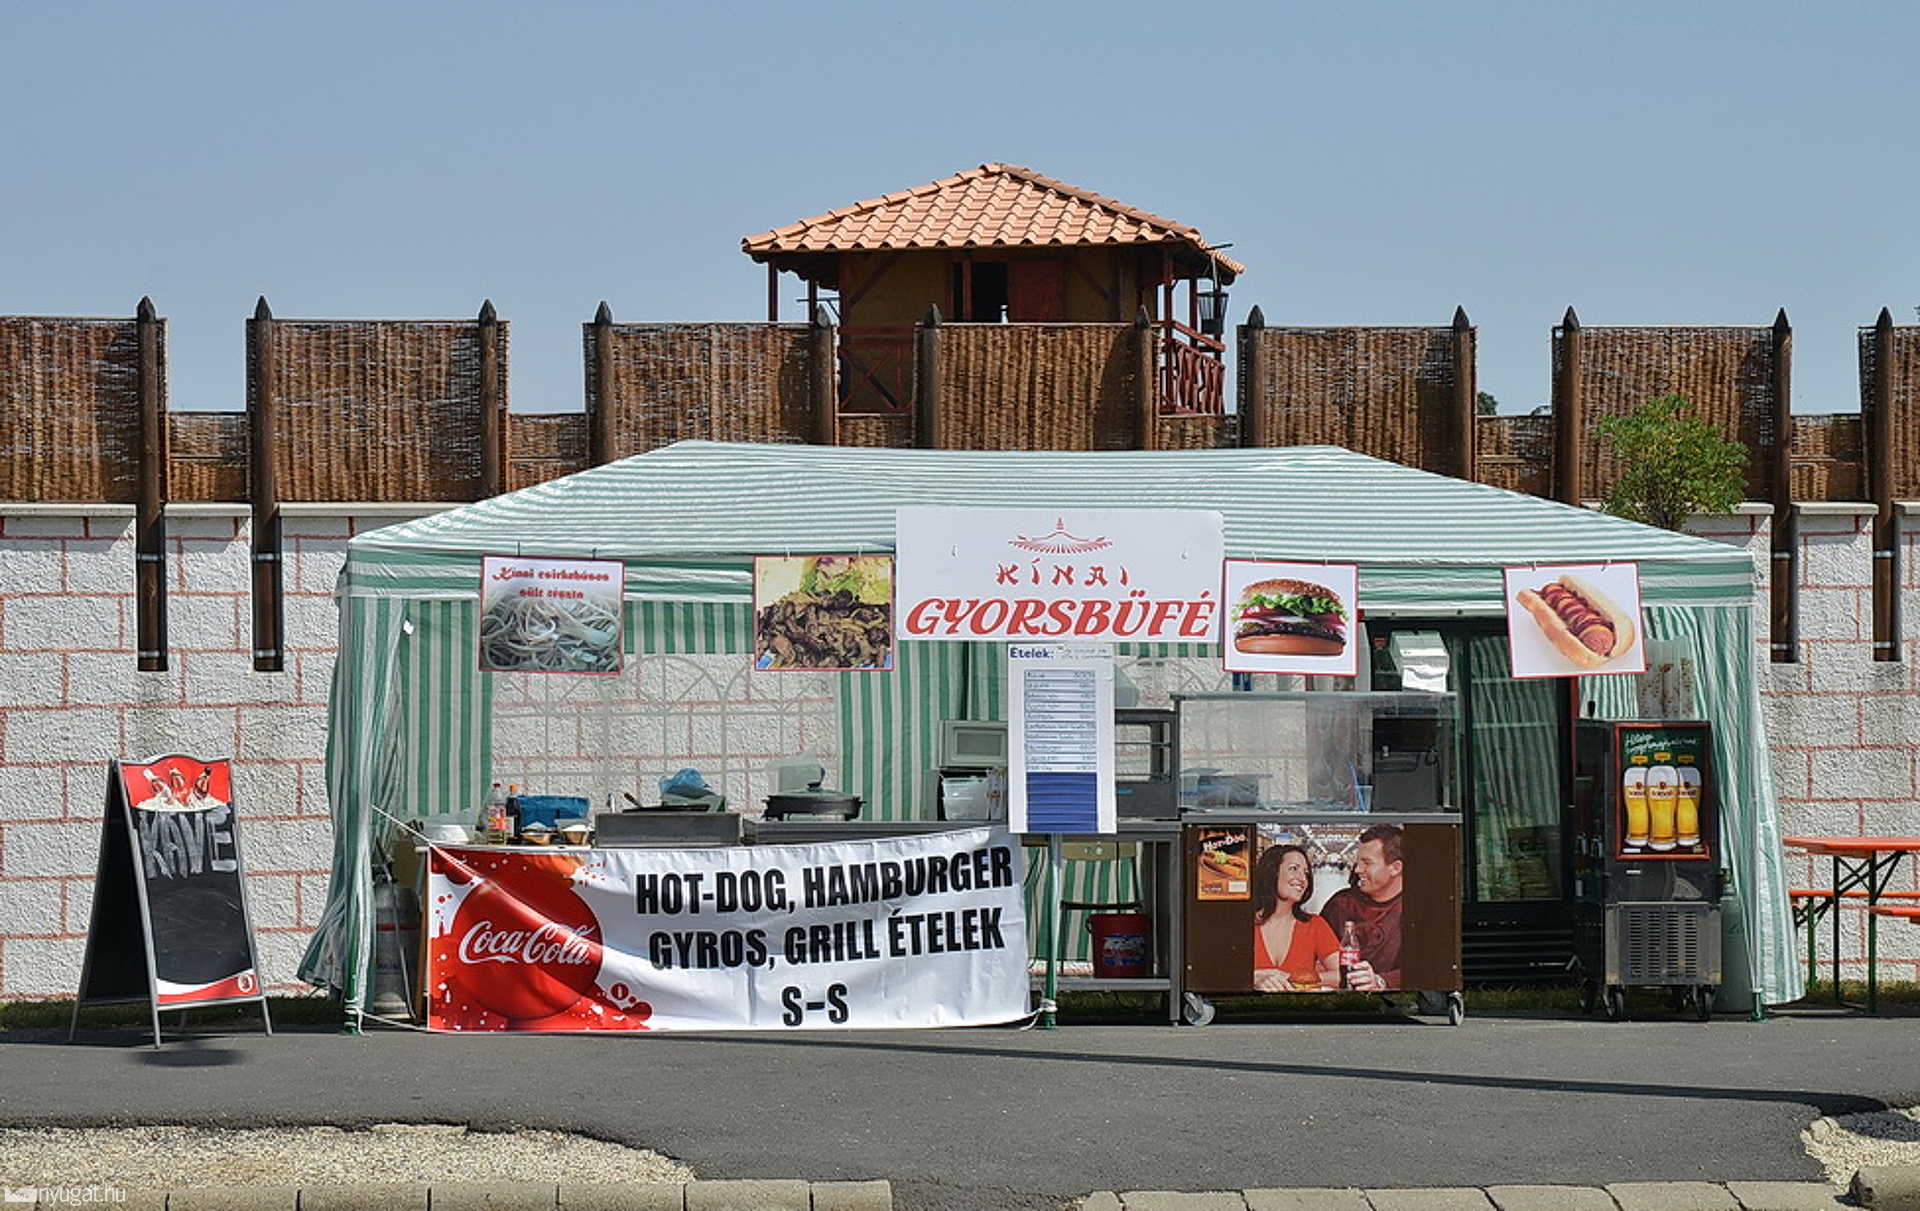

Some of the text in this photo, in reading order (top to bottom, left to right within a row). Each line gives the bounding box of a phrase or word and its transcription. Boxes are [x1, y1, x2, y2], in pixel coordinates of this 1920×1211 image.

[995, 557, 1129, 586] KÍNAI
[905, 590, 1216, 637] GYORSBÜFÉ
[635, 846, 1014, 915] HOT-DOG, HAMBURGER
[458, 920, 596, 964] Coca-Cola
[649, 907, 1005, 971] GYROS, GRILL ÉTELEK
[781, 983, 849, 1027] S-S
